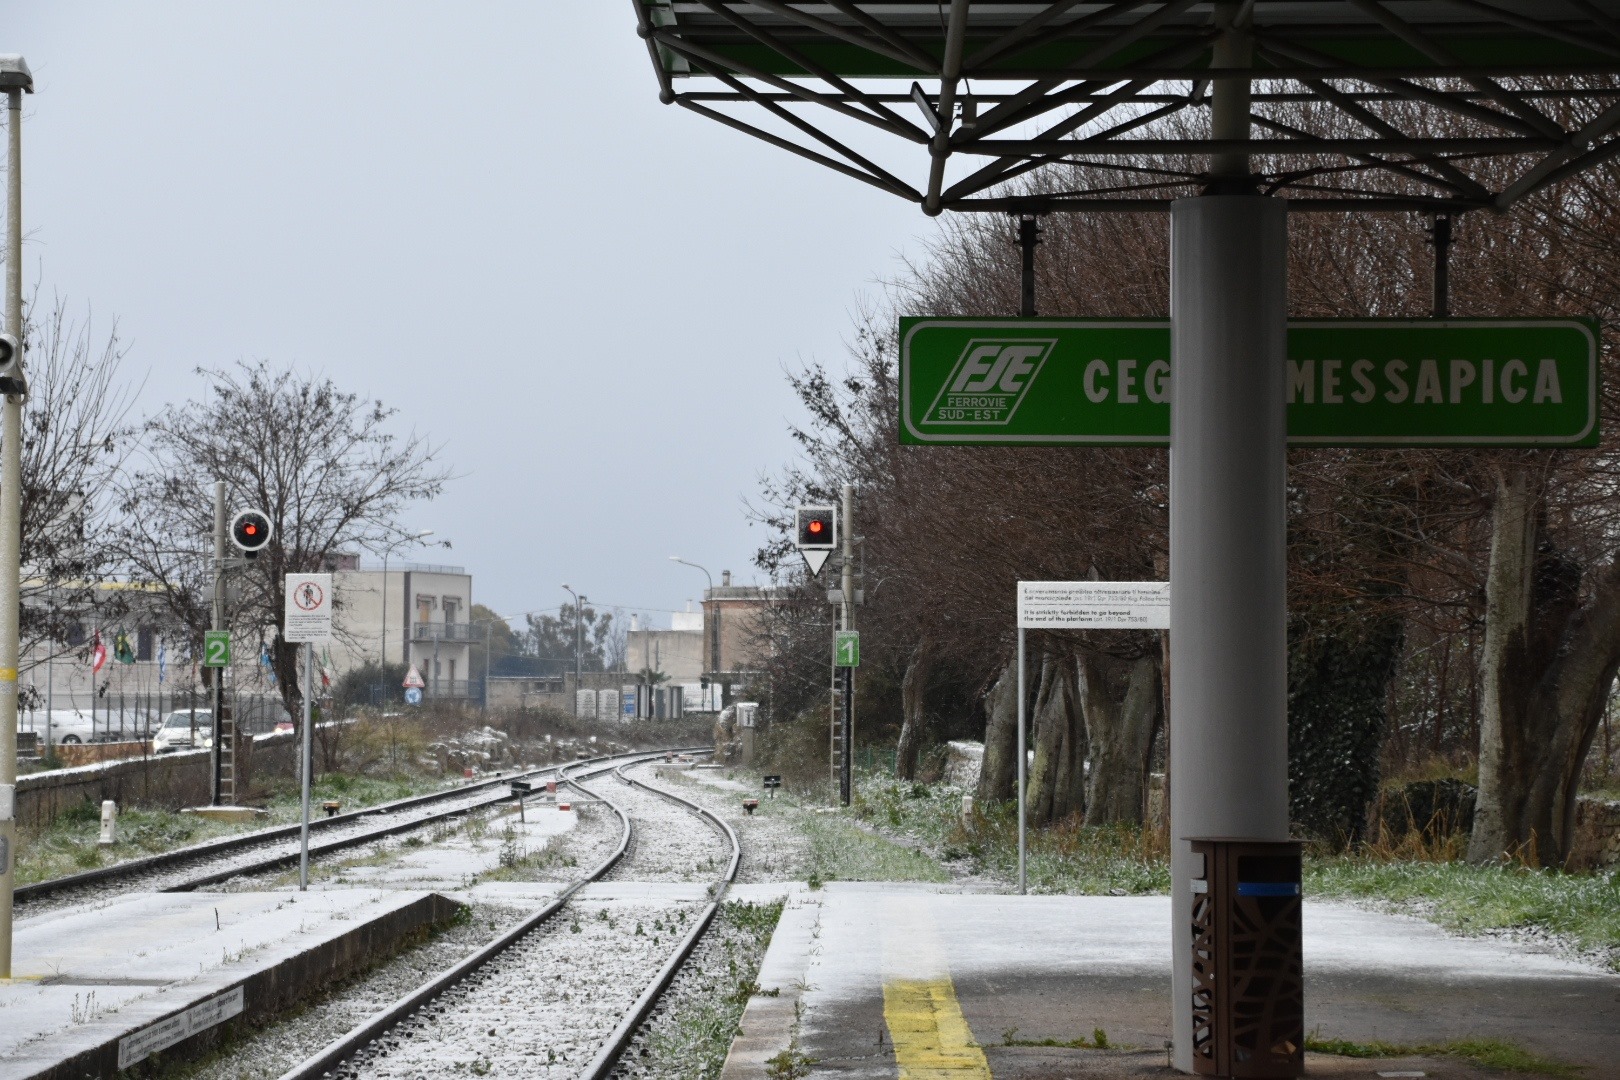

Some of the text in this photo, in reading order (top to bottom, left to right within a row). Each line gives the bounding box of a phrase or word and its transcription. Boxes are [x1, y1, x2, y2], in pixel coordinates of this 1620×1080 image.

[1083, 358, 1563, 404] CEG MESSAPICA
[948, 397, 1006, 407] FERROVIE
[938, 409, 1000, 420] SUD-EST
[208, 640, 226, 664] 2
[842, 640, 854, 664] 1
